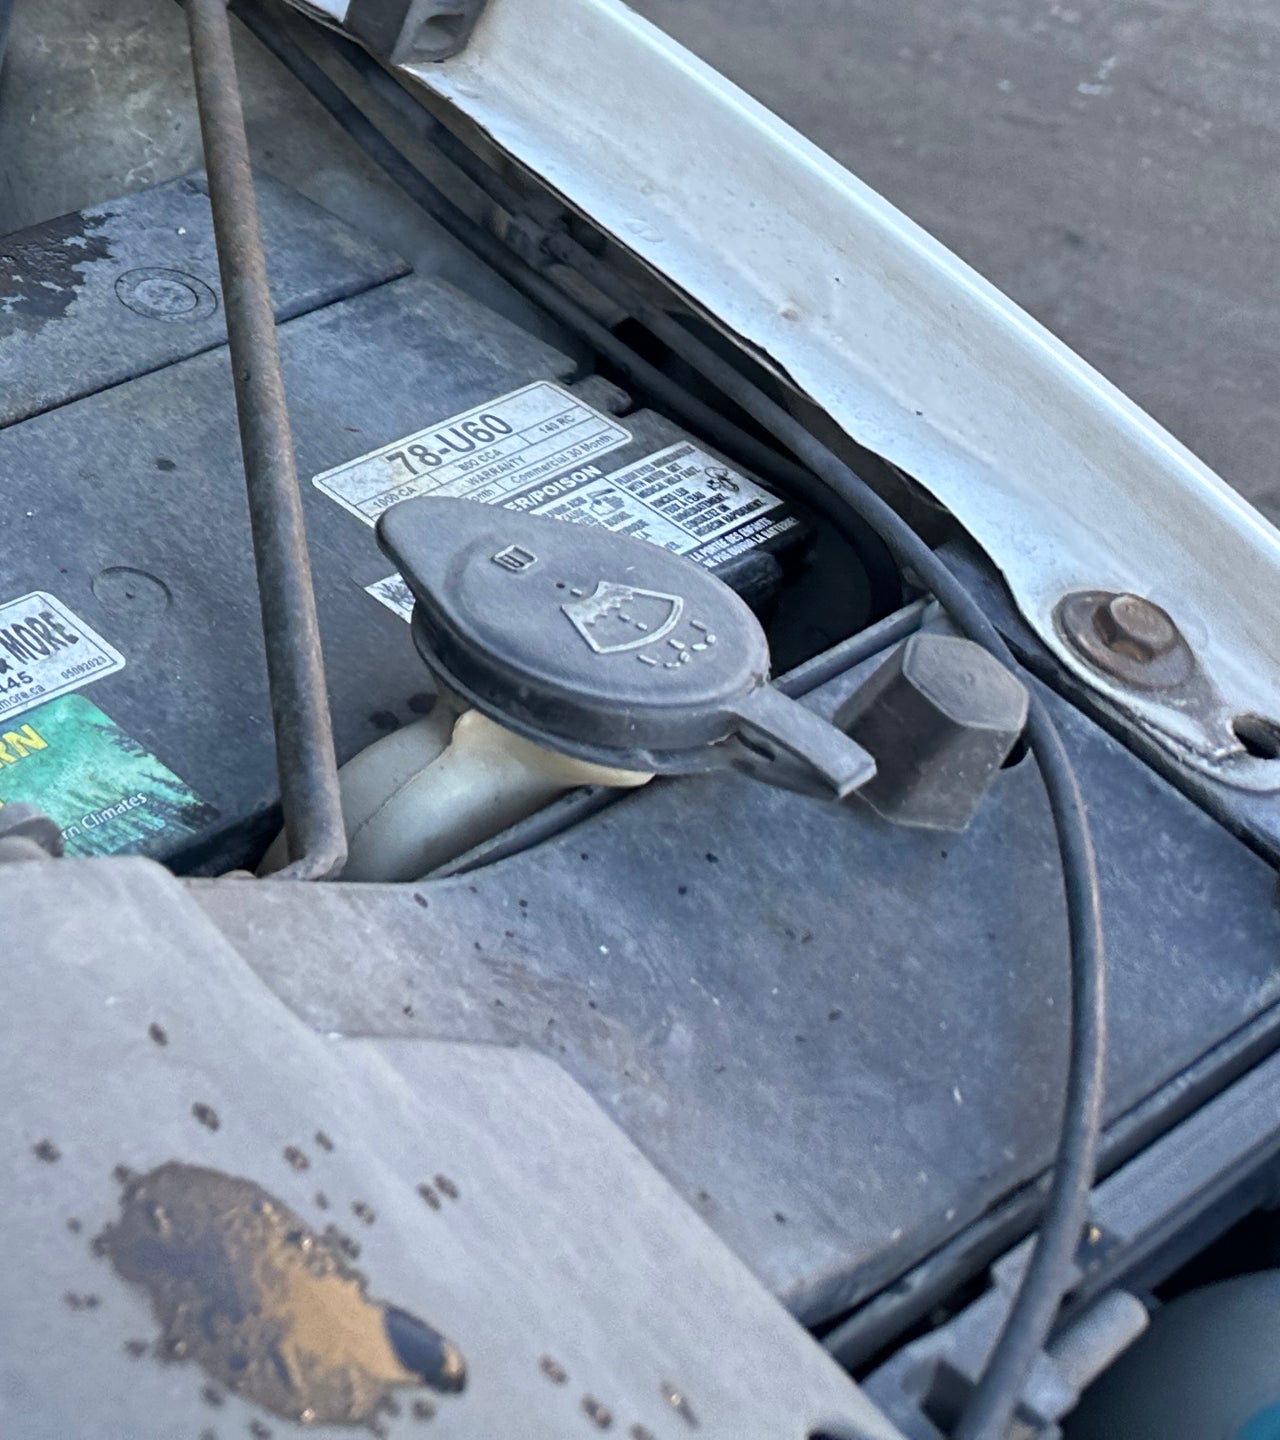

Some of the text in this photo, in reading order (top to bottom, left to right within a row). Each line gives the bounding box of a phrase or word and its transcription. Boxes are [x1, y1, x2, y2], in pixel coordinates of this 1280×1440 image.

[557, 415, 576, 427] RC
[386, 414, 513, 475] 78-U60
[477, 449, 505, 462] CCA
[510, 433, 613, 484] Commercial 30 Month
[465, 455, 528, 486] WARRANTY
[503, 465, 602, 511] ER/POISON
[82, 793, 147, 829] Climates
